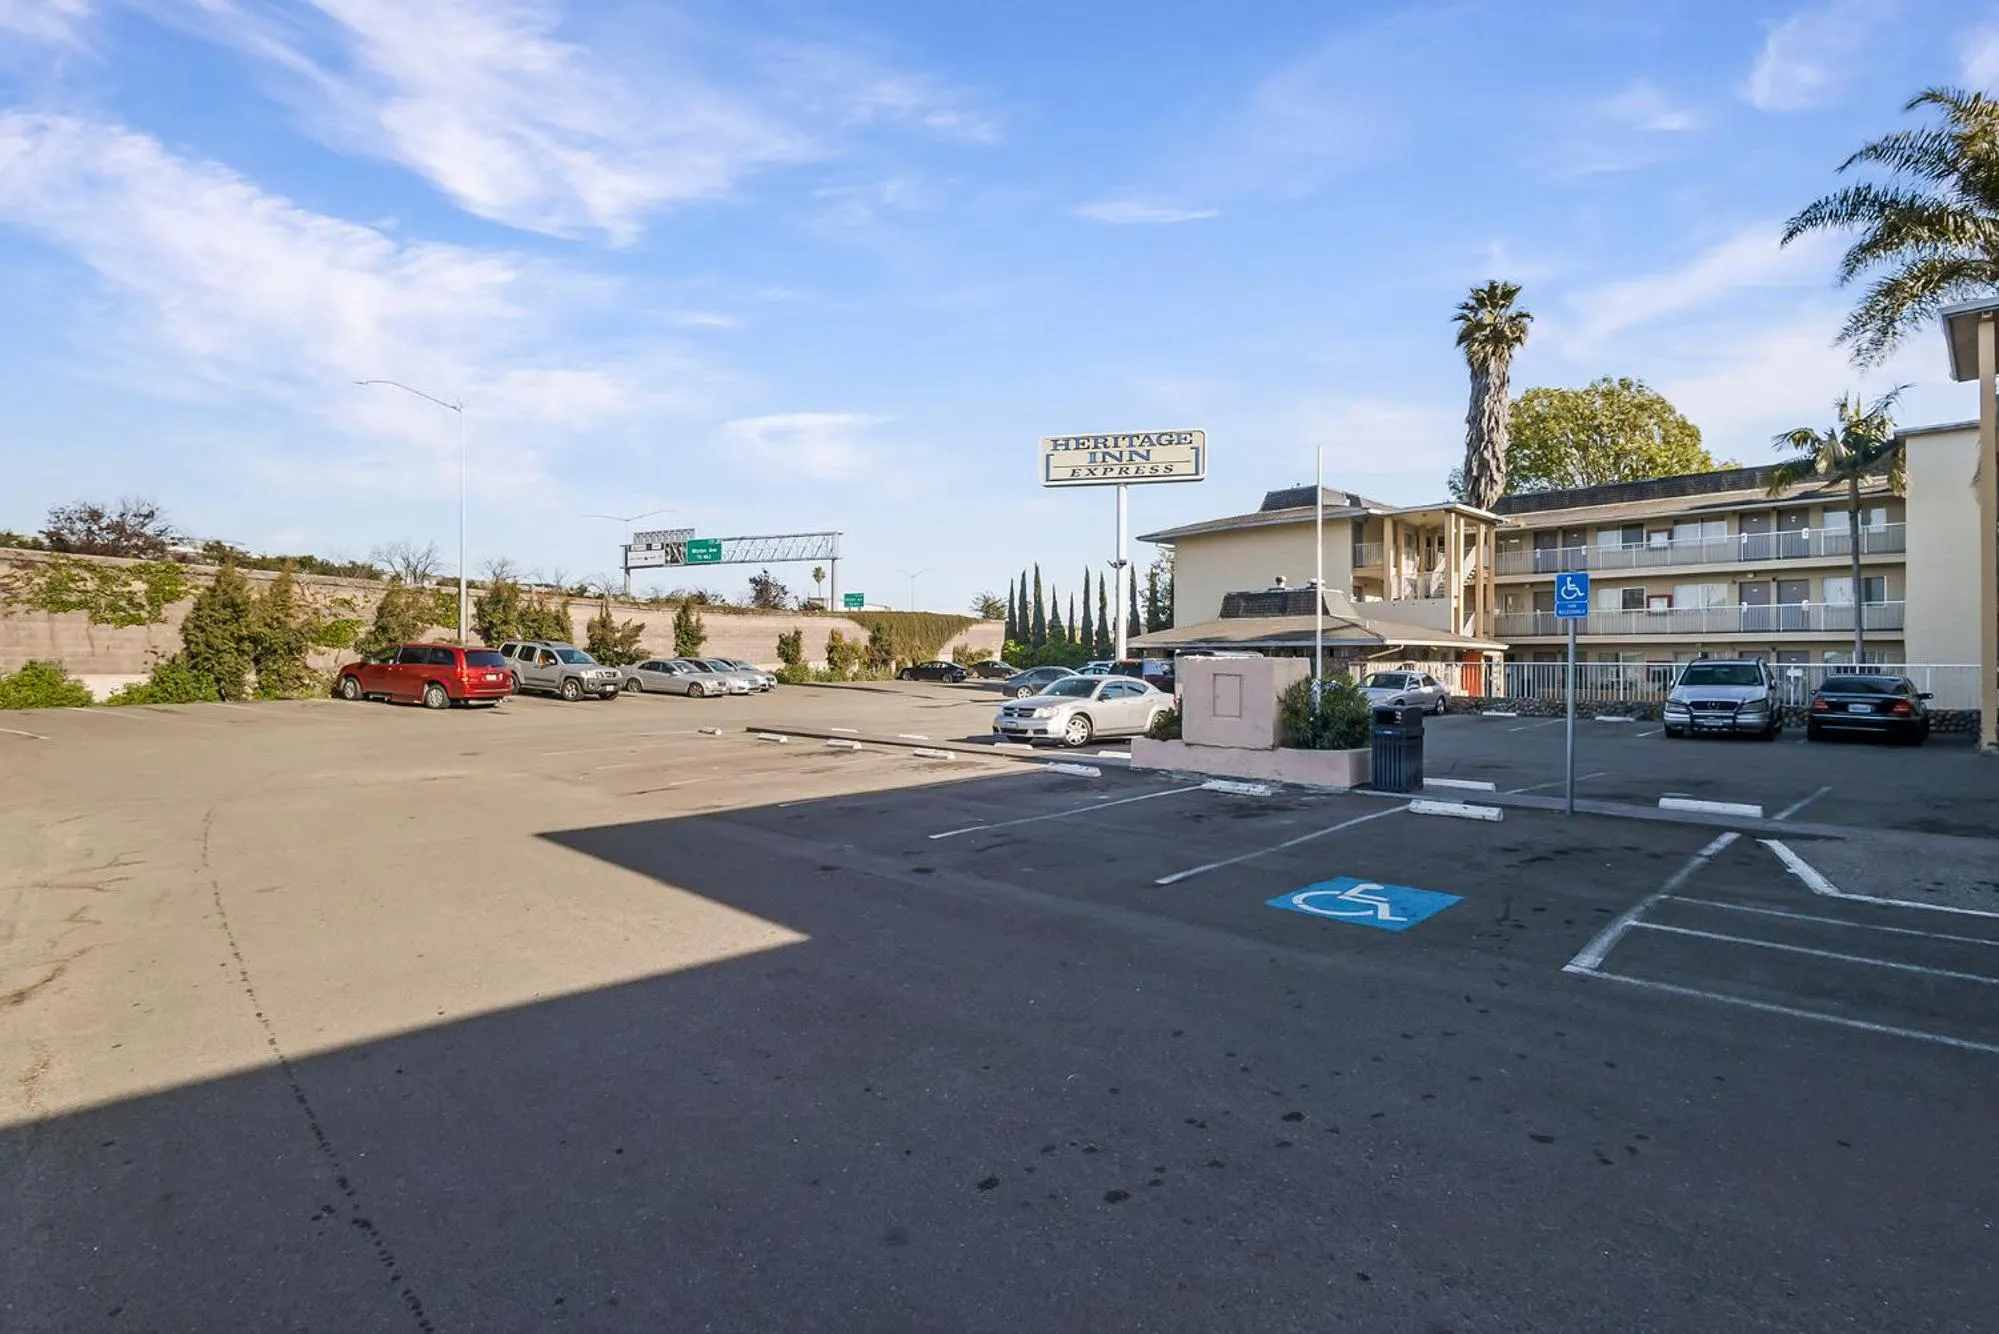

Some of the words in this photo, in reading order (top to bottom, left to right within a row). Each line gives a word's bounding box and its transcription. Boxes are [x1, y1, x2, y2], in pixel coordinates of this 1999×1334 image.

[1051, 433, 1193, 451] HERITAGE
[1088, 449, 1152, 464] INN
[1070, 465, 1175, 478] EXPRESS
